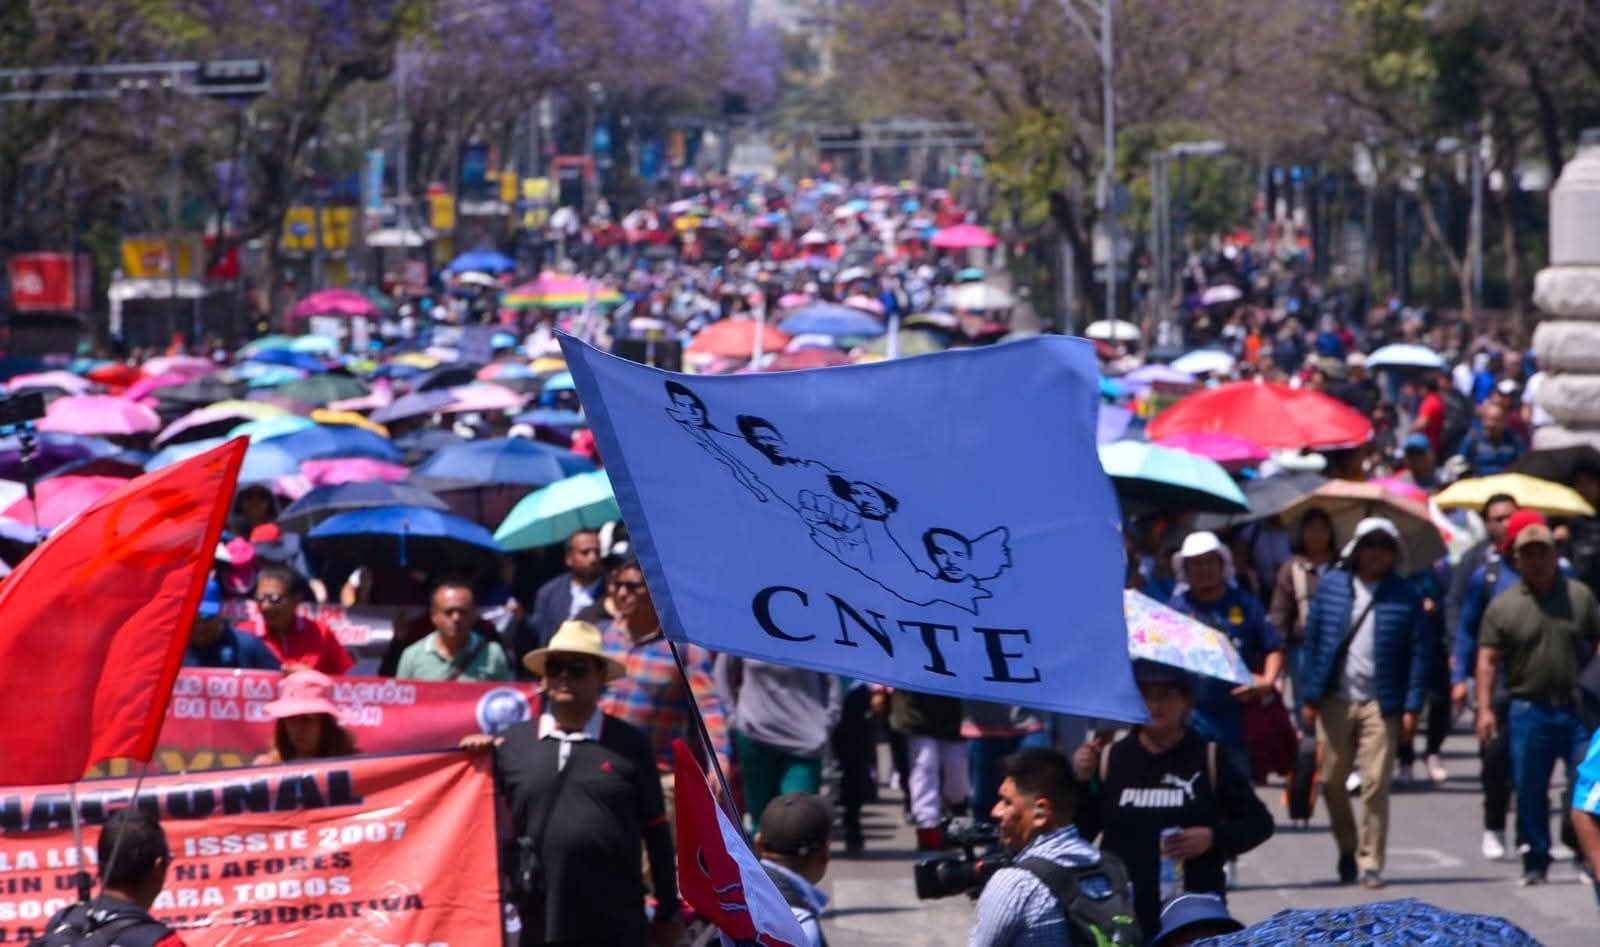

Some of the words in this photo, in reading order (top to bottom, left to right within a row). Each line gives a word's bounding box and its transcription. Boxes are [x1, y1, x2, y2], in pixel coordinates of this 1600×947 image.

[751, 585, 1042, 684] CNTE
[1118, 788, 1184, 807] PUMA
[184, 829, 308, 857] ISSSTE
[317, 822, 408, 851] 2007
[0, 875, 42, 895] IN
[151, 887, 225, 910] ARA
[233, 876, 352, 903] TODOS
